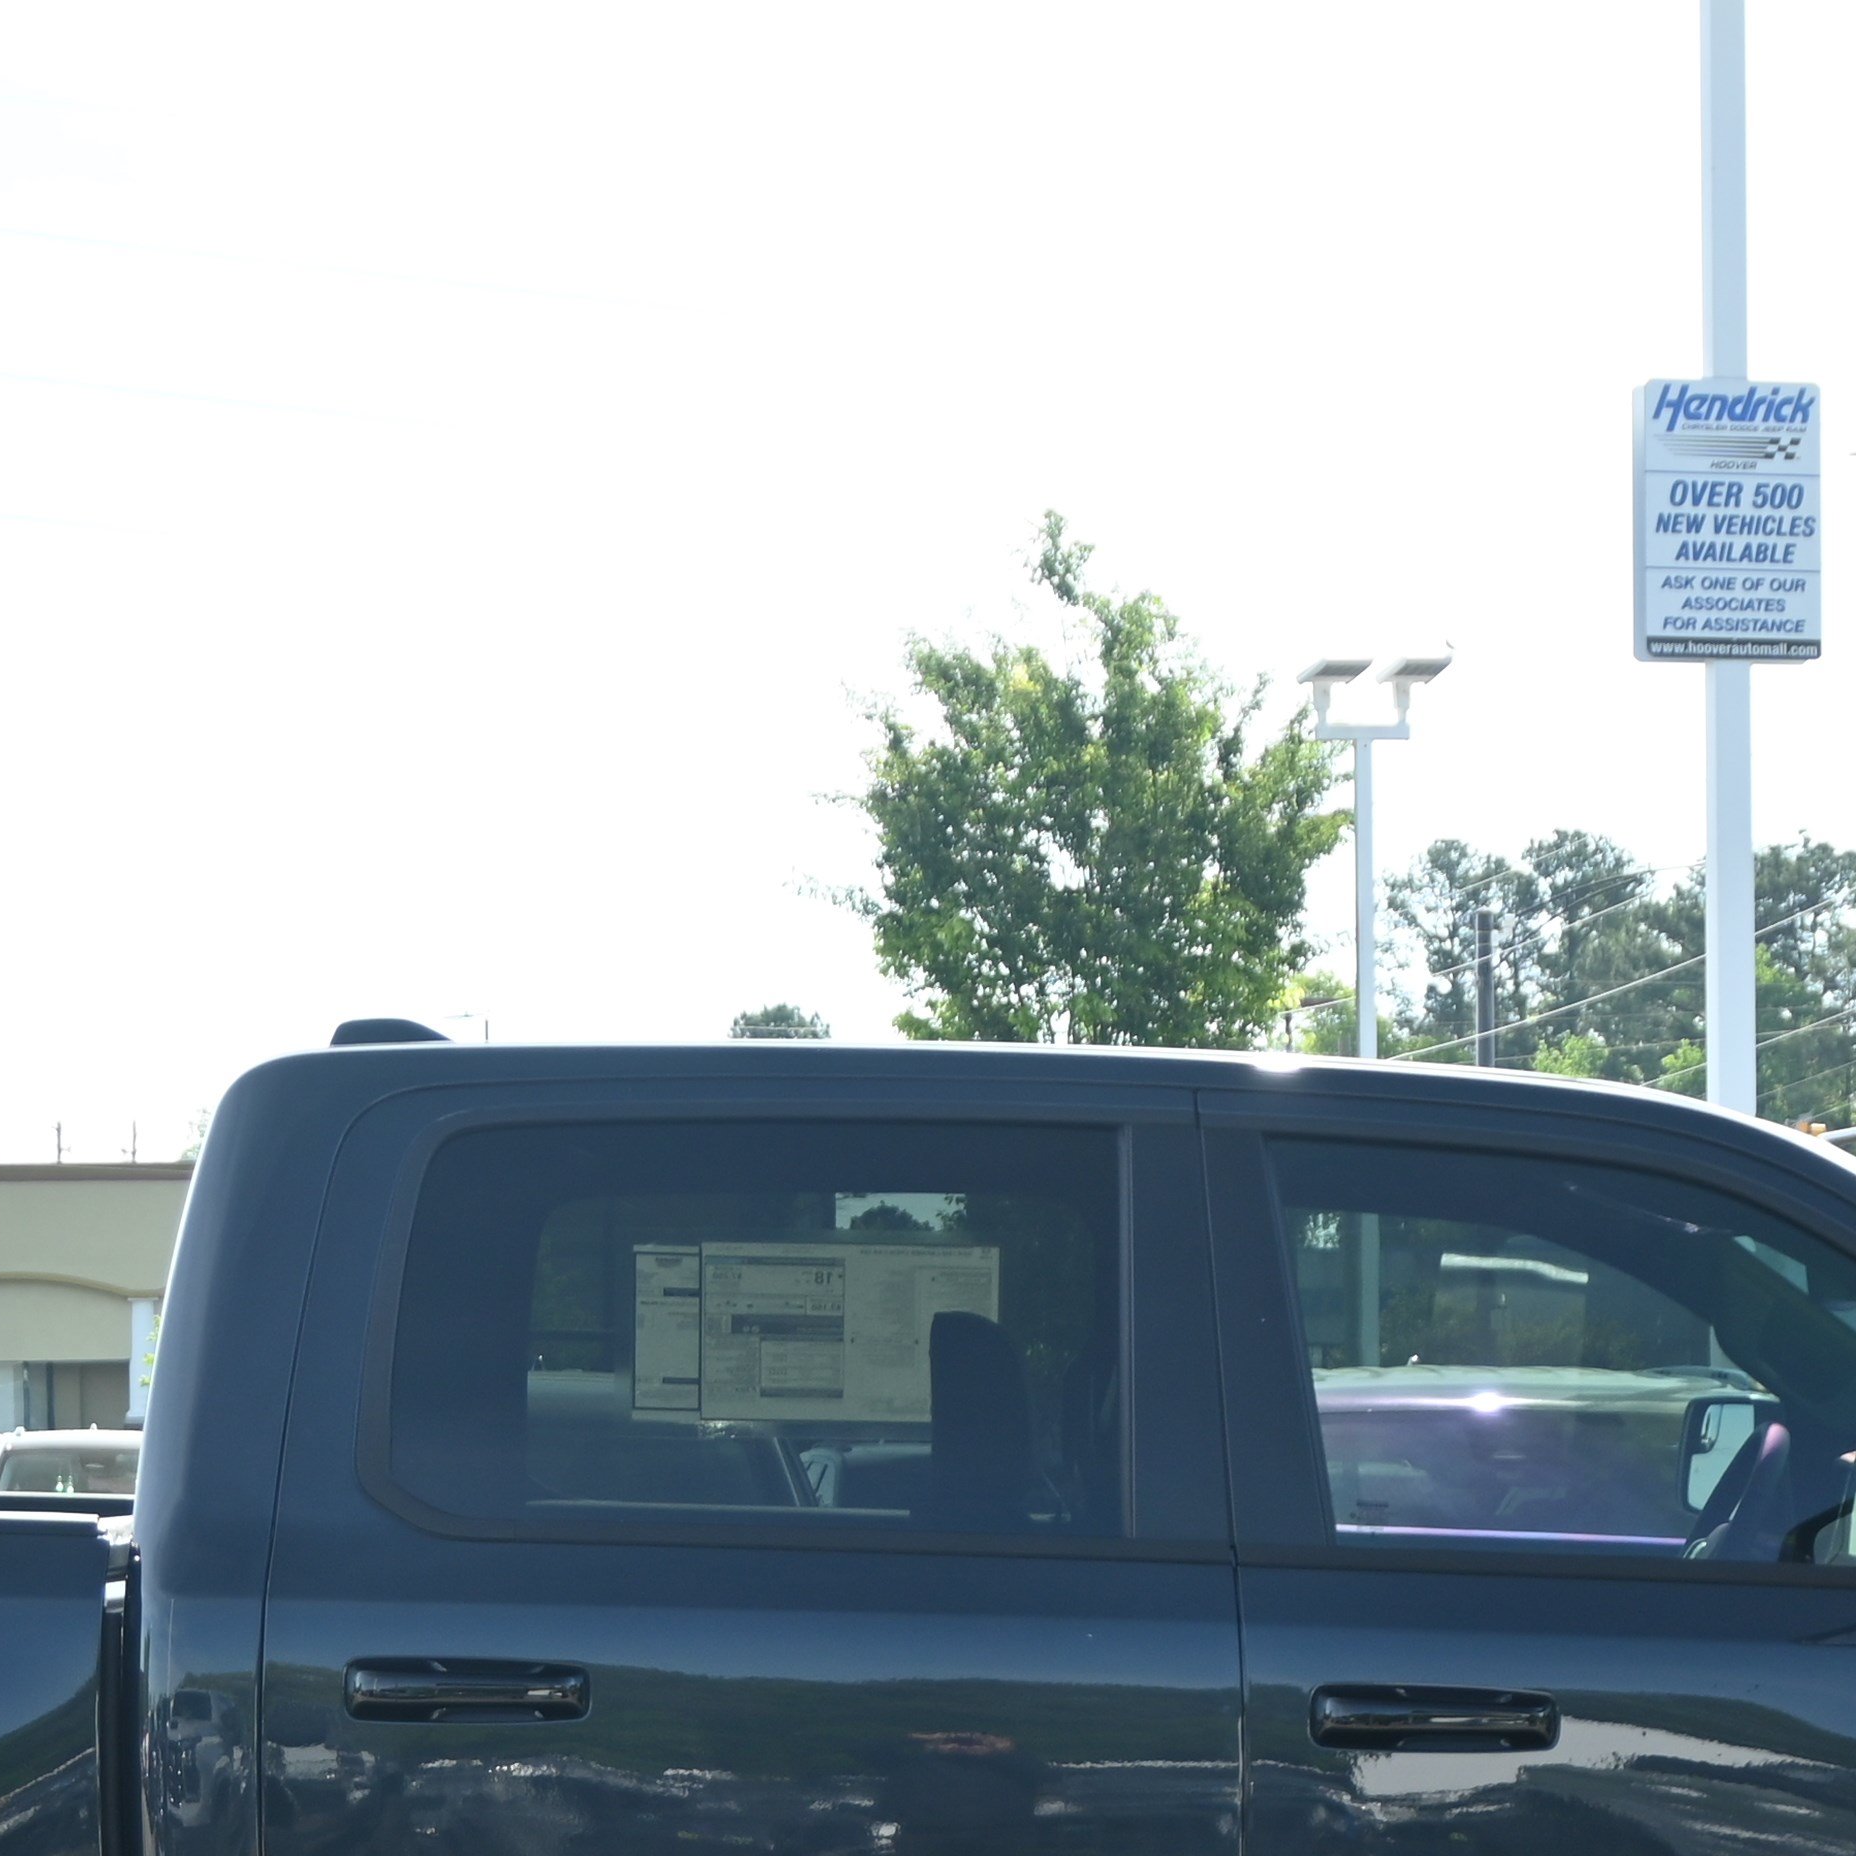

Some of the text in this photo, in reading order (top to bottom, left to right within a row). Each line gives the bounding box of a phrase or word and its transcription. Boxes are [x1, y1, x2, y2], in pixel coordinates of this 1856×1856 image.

[1652, 383, 1816, 432] Hendrick
[1710, 460, 1757, 470] HOOVER
[1669, 479, 1804, 510] OVER 500
[1655, 512, 1816, 538] NEW VEHICLES
[1674, 539, 1797, 564] AVAILABLE
[1661, 575, 1806, 593] ASK ONE OF OUR
[1681, 596, 1786, 613] ASSOCIATES
[1662, 615, 1806, 634] FOR ASSISTANCE
[1650, 640, 1818, 658] www.hooverautomall.com
